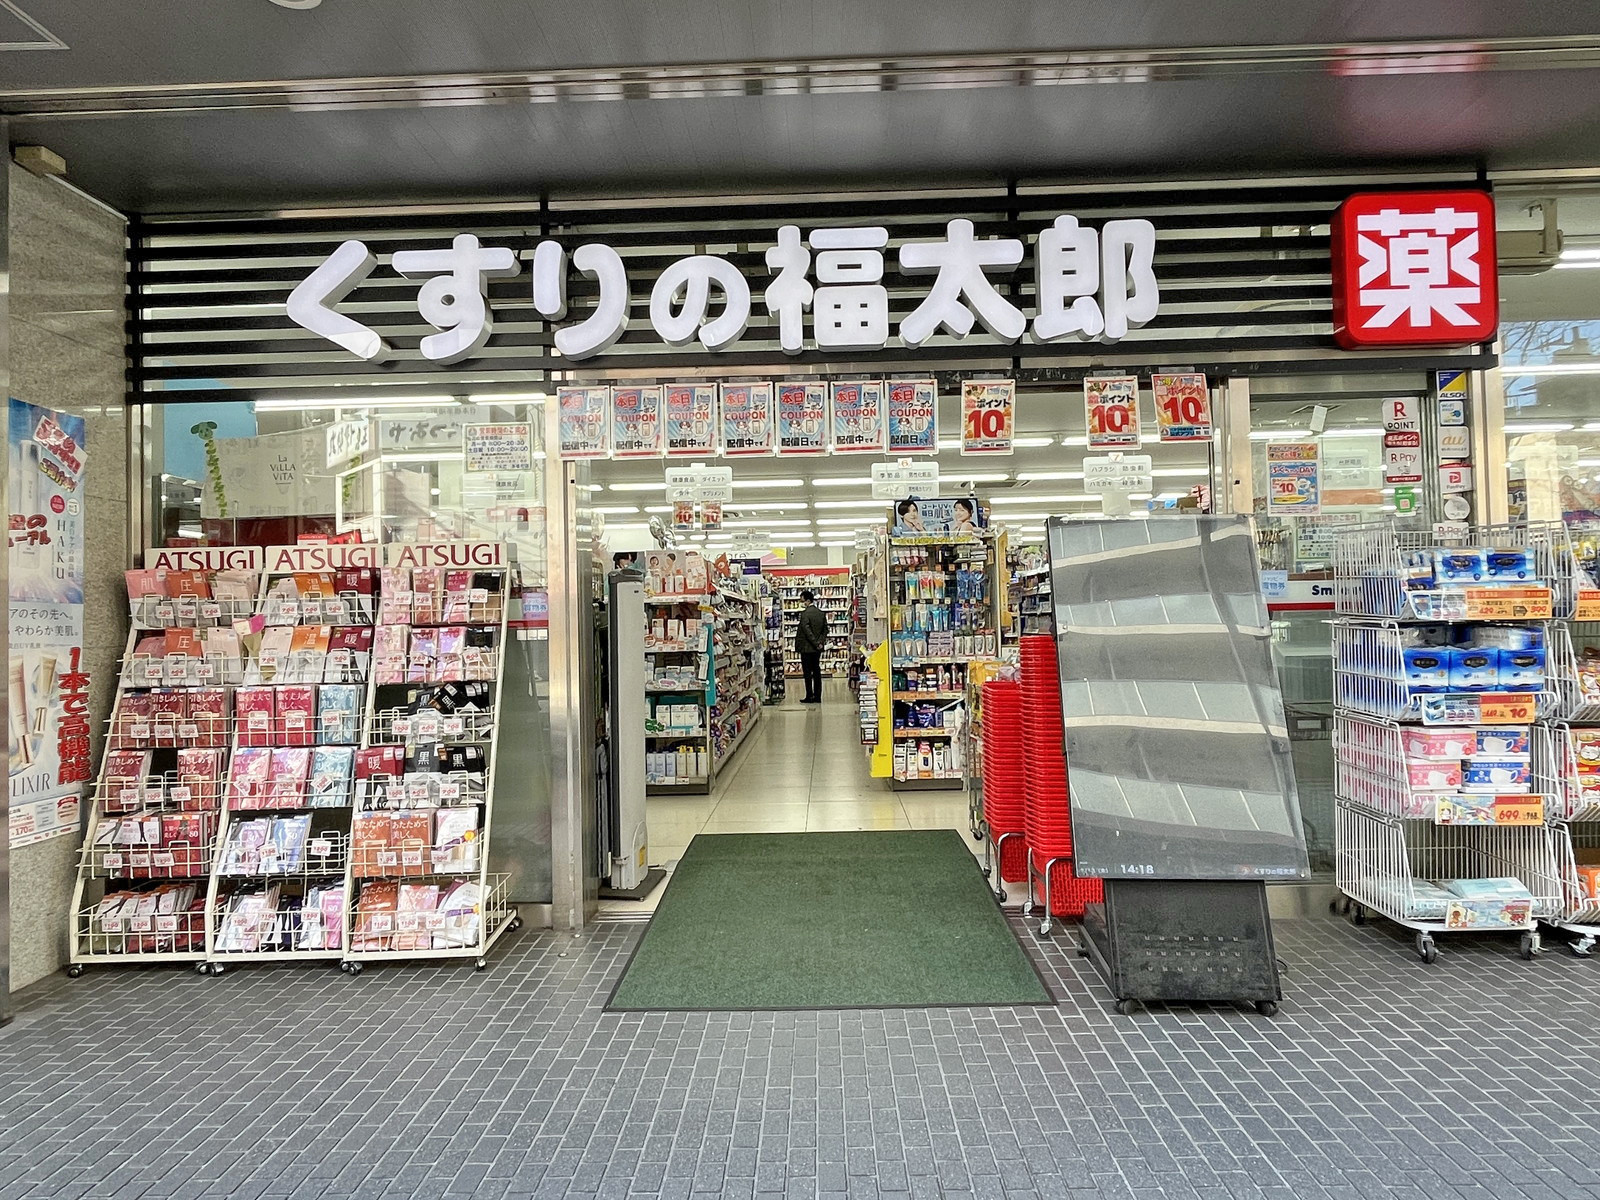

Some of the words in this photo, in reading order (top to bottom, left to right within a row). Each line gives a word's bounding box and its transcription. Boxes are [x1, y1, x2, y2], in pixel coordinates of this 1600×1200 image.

[1357, 207, 1481, 328] 薬
[286, 214, 1160, 365] くすりの福太郎
[835, 408, 877, 418] COUPON
[889, 408, 933, 418] COUPON
[1163, 397, 1203, 424] 10
[1394, 401, 1407, 417] R
[614, 413, 656, 423] COUPON
[668, 411, 710, 421] COUPON
[724, 410, 766, 421] COUPON
[780, 411, 823, 420] COUPON
[1092, 405, 1129, 433] 10
[968, 410, 1005, 438] 10
[1388, 421, 1415, 430] POINT
[1442, 435, 1465, 446] au
[278, 455, 288, 463] La
[1400, 453, 1417, 463] Pay
[1280, 482, 1295, 493] 10
[57, 519, 66, 580] HAKU
[395, 543, 501, 568] ATSUGI
[155, 550, 255, 571] ATSUGI
[274, 547, 377, 571] ATSUGI
[346, 573, 359, 587] 暖
[344, 633, 358, 645] 暖
[368, 755, 382, 770] 暖
[418, 751, 429, 766] 黒
[452, 753, 465, 768] 黒
[1499, 810, 1519, 820] 699
[392, 820, 429, 829] あたためて
[1120, 864, 1155, 874] 14:18
